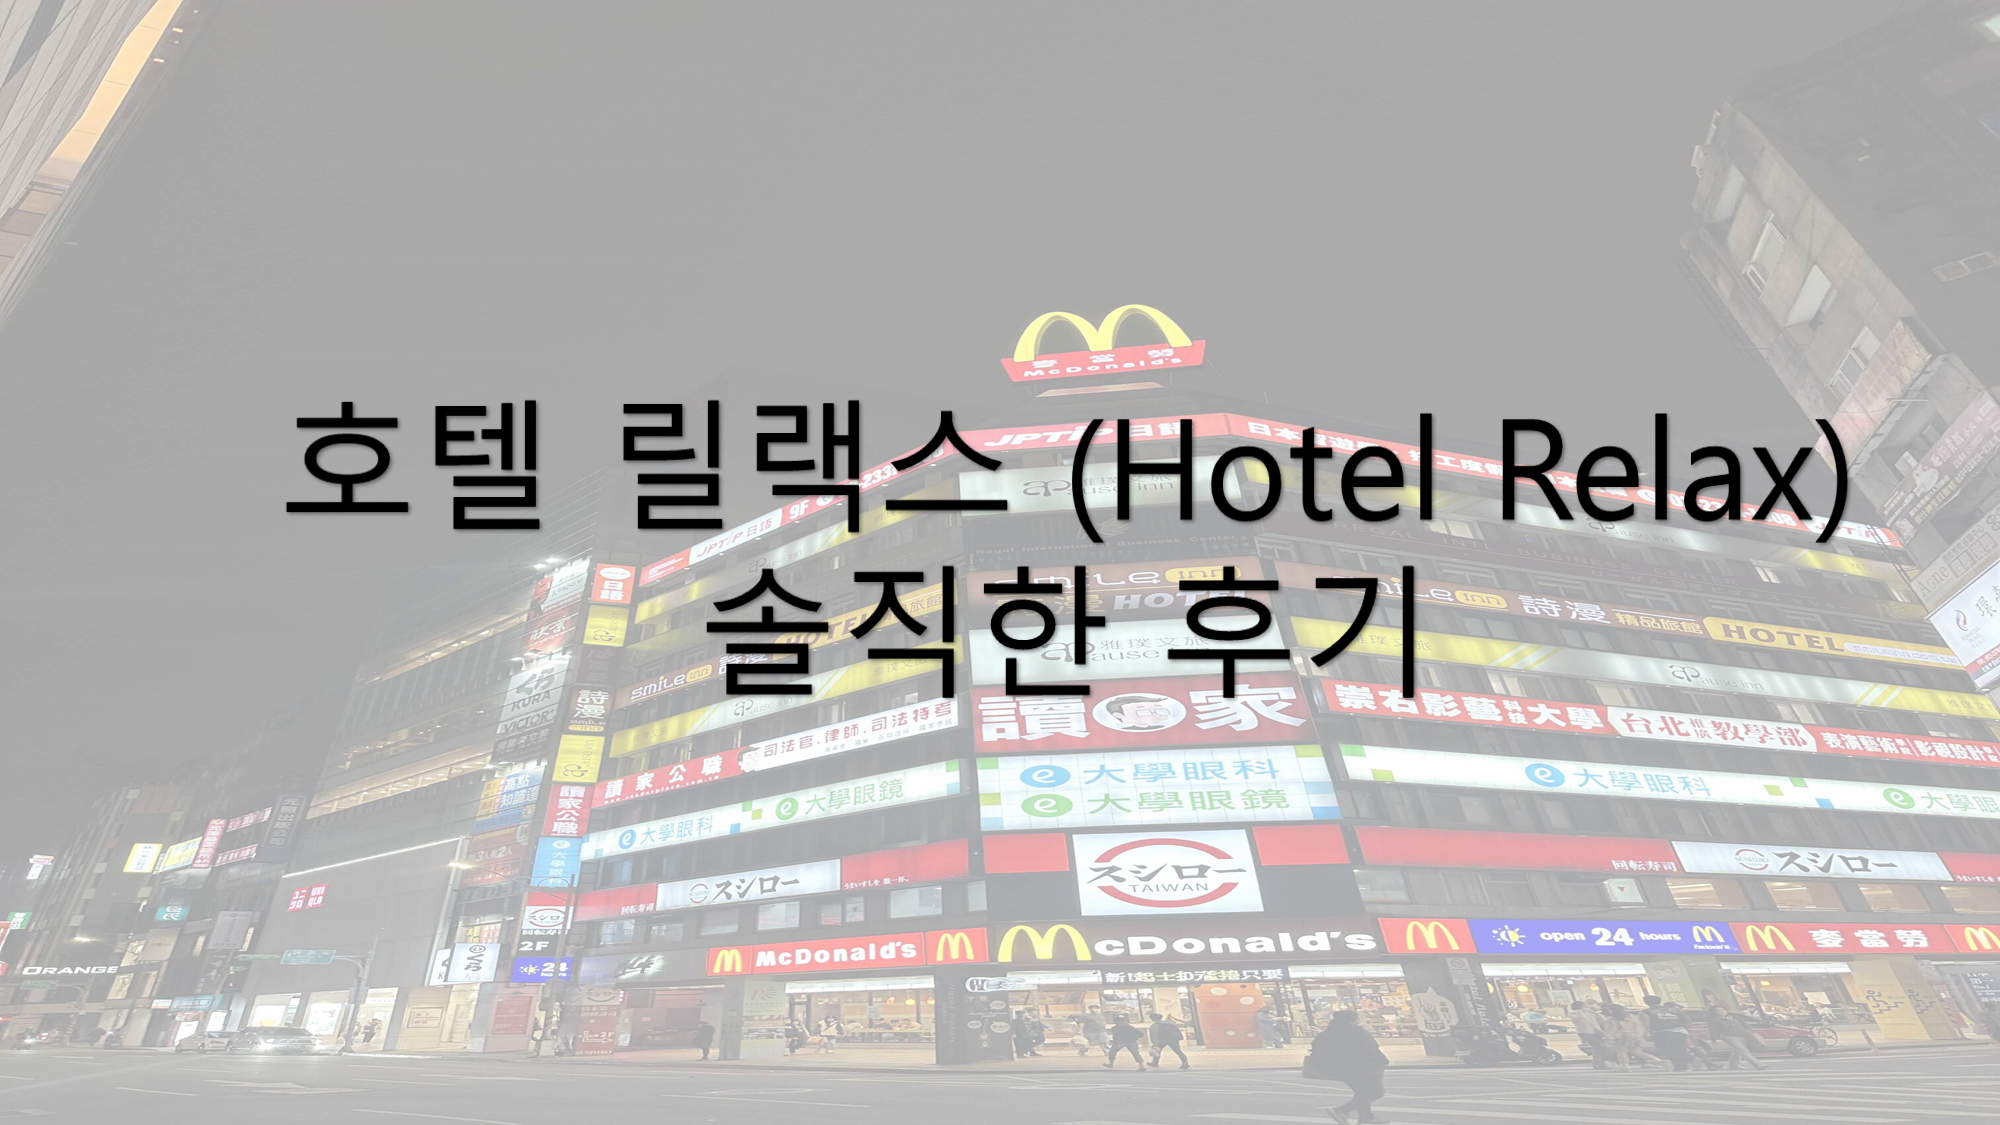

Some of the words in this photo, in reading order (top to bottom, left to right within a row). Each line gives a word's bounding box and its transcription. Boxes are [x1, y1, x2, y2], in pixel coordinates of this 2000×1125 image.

[1022, 355, 1183, 378] McDonald's
[746, 517, 773, 538] 日語
[789, 500, 810, 520] 9F
[1021, 541, 1110, 553] International
[1333, 520, 1419, 541] REGAL
[1517, 548, 1634, 572] BUSINESS
[1652, 566, 1740, 586] CENTER
[599, 581, 625, 601] 日語
[1516, 594, 1613, 626] 詩漫
[1614, 611, 1704, 635] 精品旅館
[1719, 622, 1846, 653] HOTEL
[1741, 678, 1764, 691] inn
[511, 690, 552, 712] KURA
[572, 689, 610, 720] 詩漫
[1189, 684, 1307, 733] 家
[505, 773, 530, 792] 高點
[603, 755, 723, 800] 讀家公職
[1083, 757, 1280, 786] 大學眼科
[1573, 767, 1711, 798] 大學眼科
[500, 786, 539, 808] 知識達
[1087, 788, 1292, 816] 大學眼鏡
[551, 785, 588, 835] 讀家公職
[640, 814, 714, 846] 大學眼科
[805, 778, 904, 815] 大學眼鏡
[546, 851, 571, 887] 大學眼科
[1086, 862, 1248, 885] スシロー
[1611, 859, 1679, 873] 回転寿司
[1771, 850, 1899, 874] スシロー
[310, 885, 326, 896] UNI
[620, 901, 655, 915] 回転寿司
[712, 874, 801, 902] スシロー
[1129, 883, 1210, 893] TAIWAN
[527, 914, 563, 923] スシロ
[518, 940, 550, 951] 2F
[1539, 930, 1586, 944] open
[1591, 928, 1635, 946] 24
[1639, 930, 1682, 942] hours
[1808, 929, 1930, 949] 麥當勞
[755, 940, 918, 968] McDonald's
[22, 965, 119, 975] ORANGE
